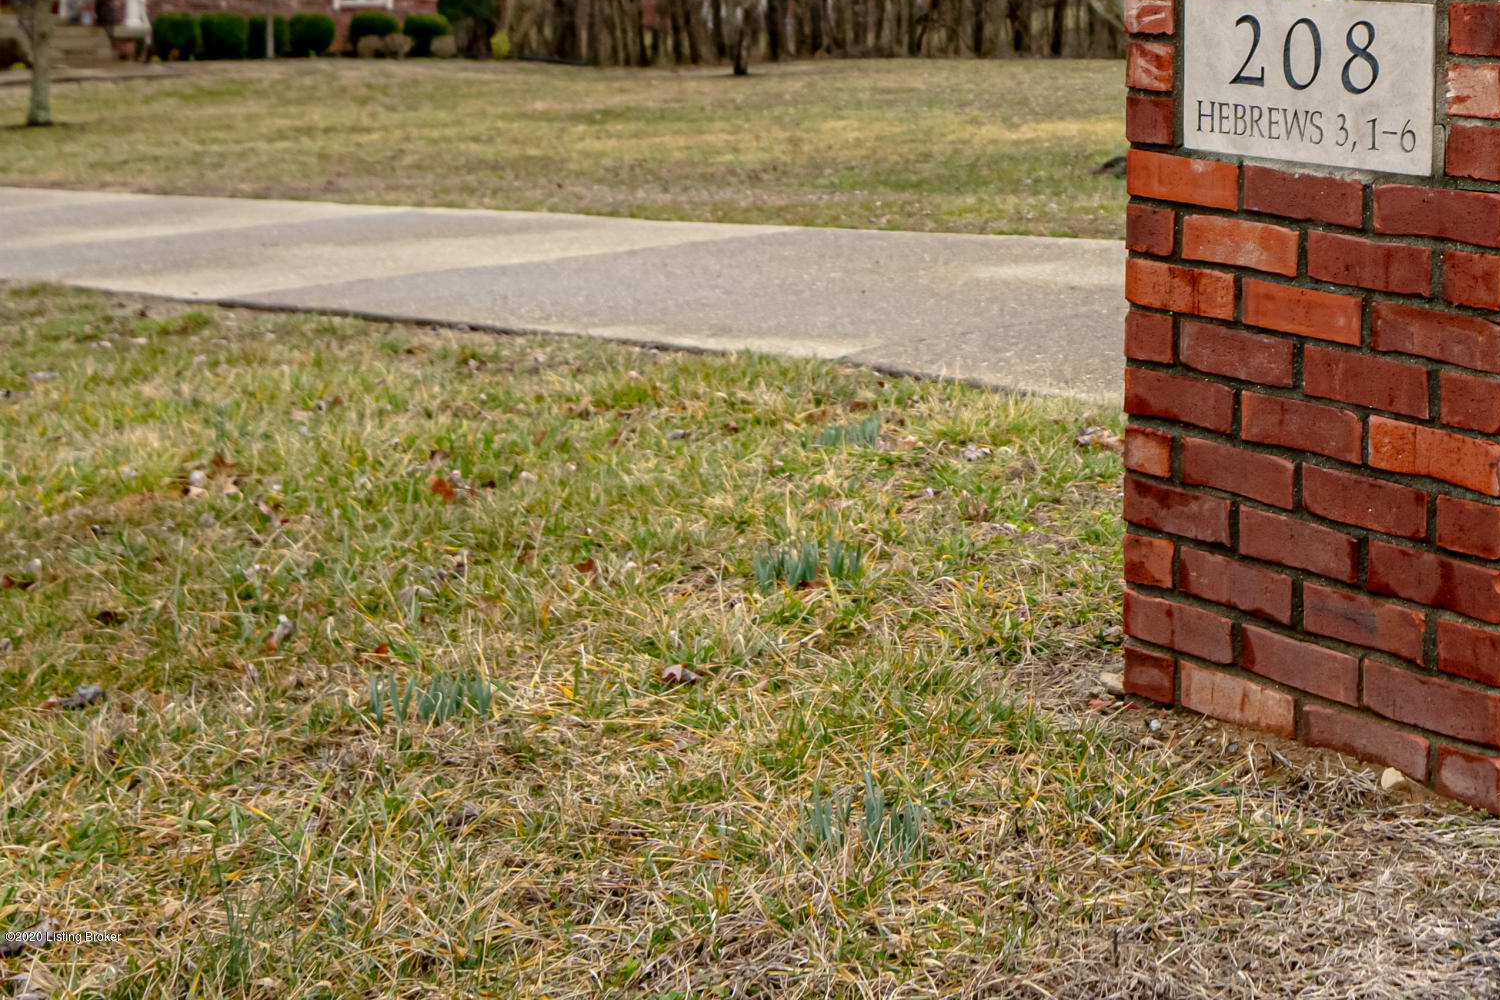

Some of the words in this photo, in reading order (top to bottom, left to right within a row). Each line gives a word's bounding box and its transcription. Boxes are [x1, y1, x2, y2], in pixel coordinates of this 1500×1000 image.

[1229, 13, 1380, 95] 208
[1196, 100, 1324, 145] HEBREWS
[1335, 113, 1358, 153] 3,
